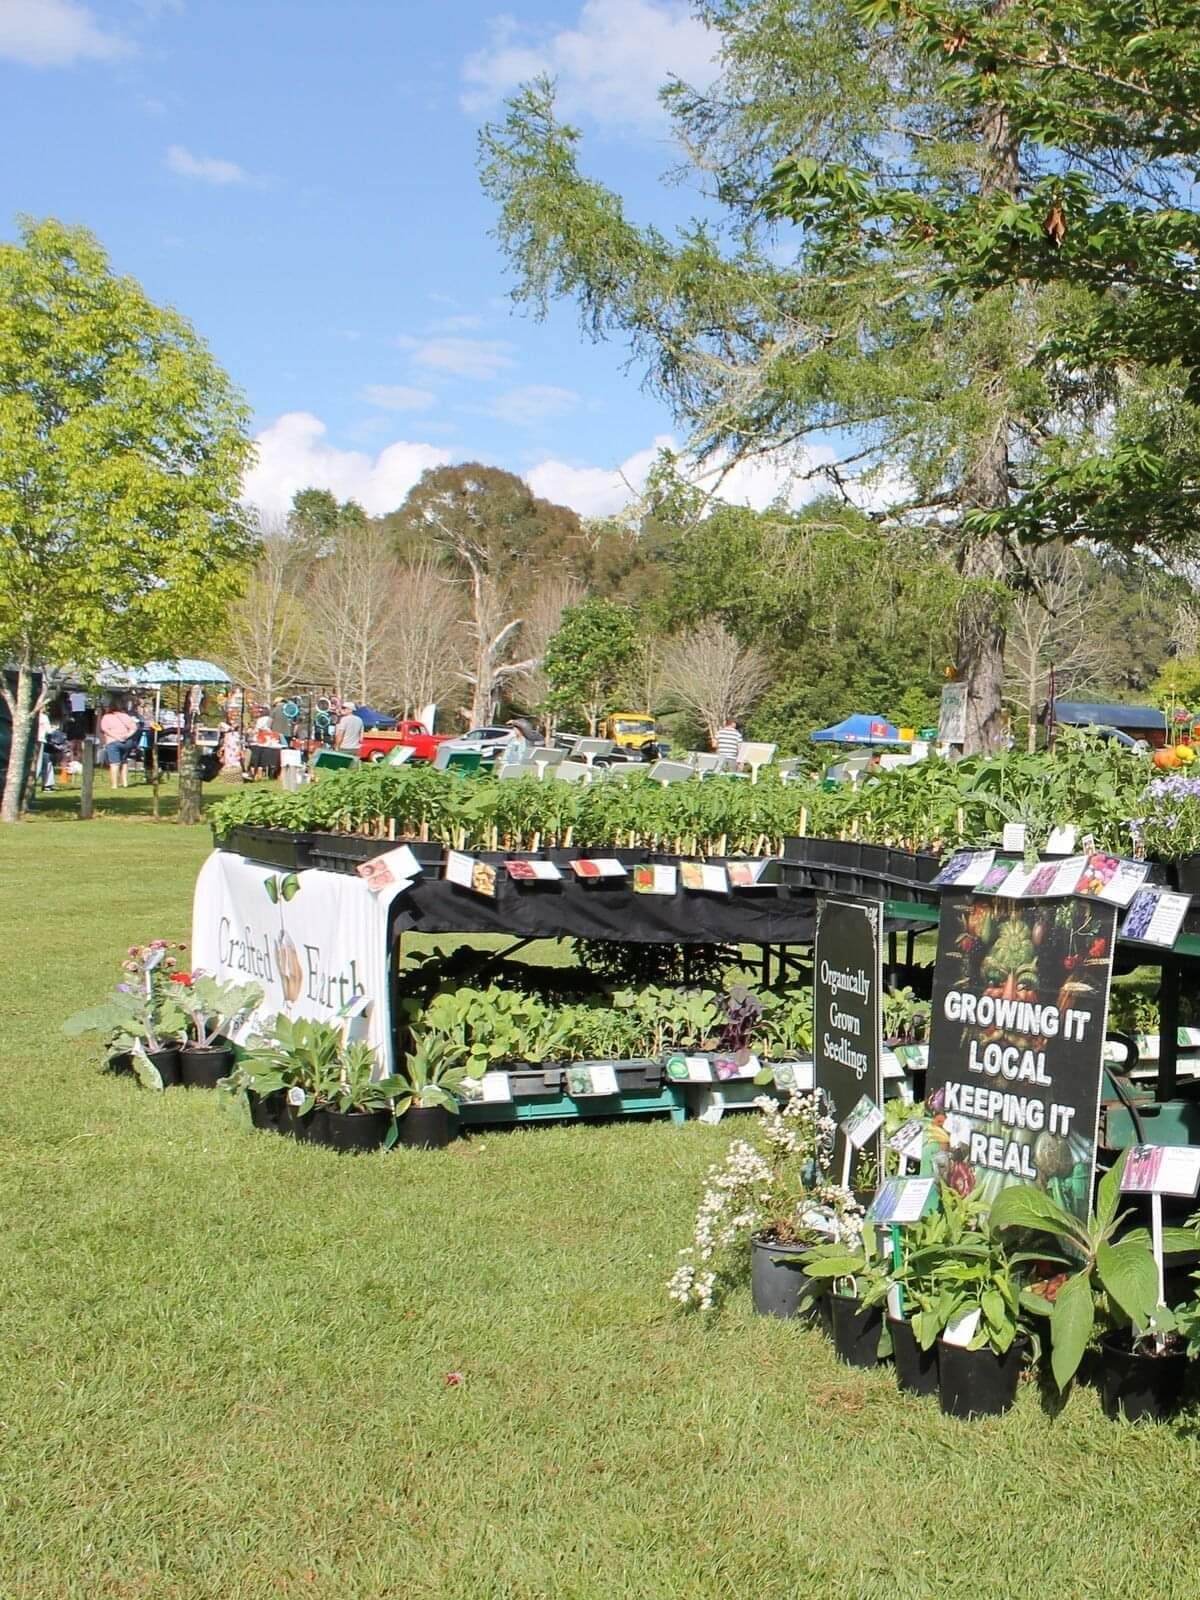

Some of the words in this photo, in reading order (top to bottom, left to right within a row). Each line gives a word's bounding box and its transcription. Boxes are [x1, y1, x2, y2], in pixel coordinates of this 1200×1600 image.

[218, 916, 274, 983] Crafted
[821, 960, 870, 1005] Organically
[830, 1002, 860, 1035] Grown
[944, 991, 1060, 1038] GROWING
[1063, 1008, 1091, 1042] IT
[823, 1033, 867, 1080] Seedlings
[968, 1040, 1052, 1086] LOCAL
[944, 1081, 1044, 1131] KEEPING
[1049, 1103, 1076, 1137] IT
[970, 1132, 1037, 1179] REAL
